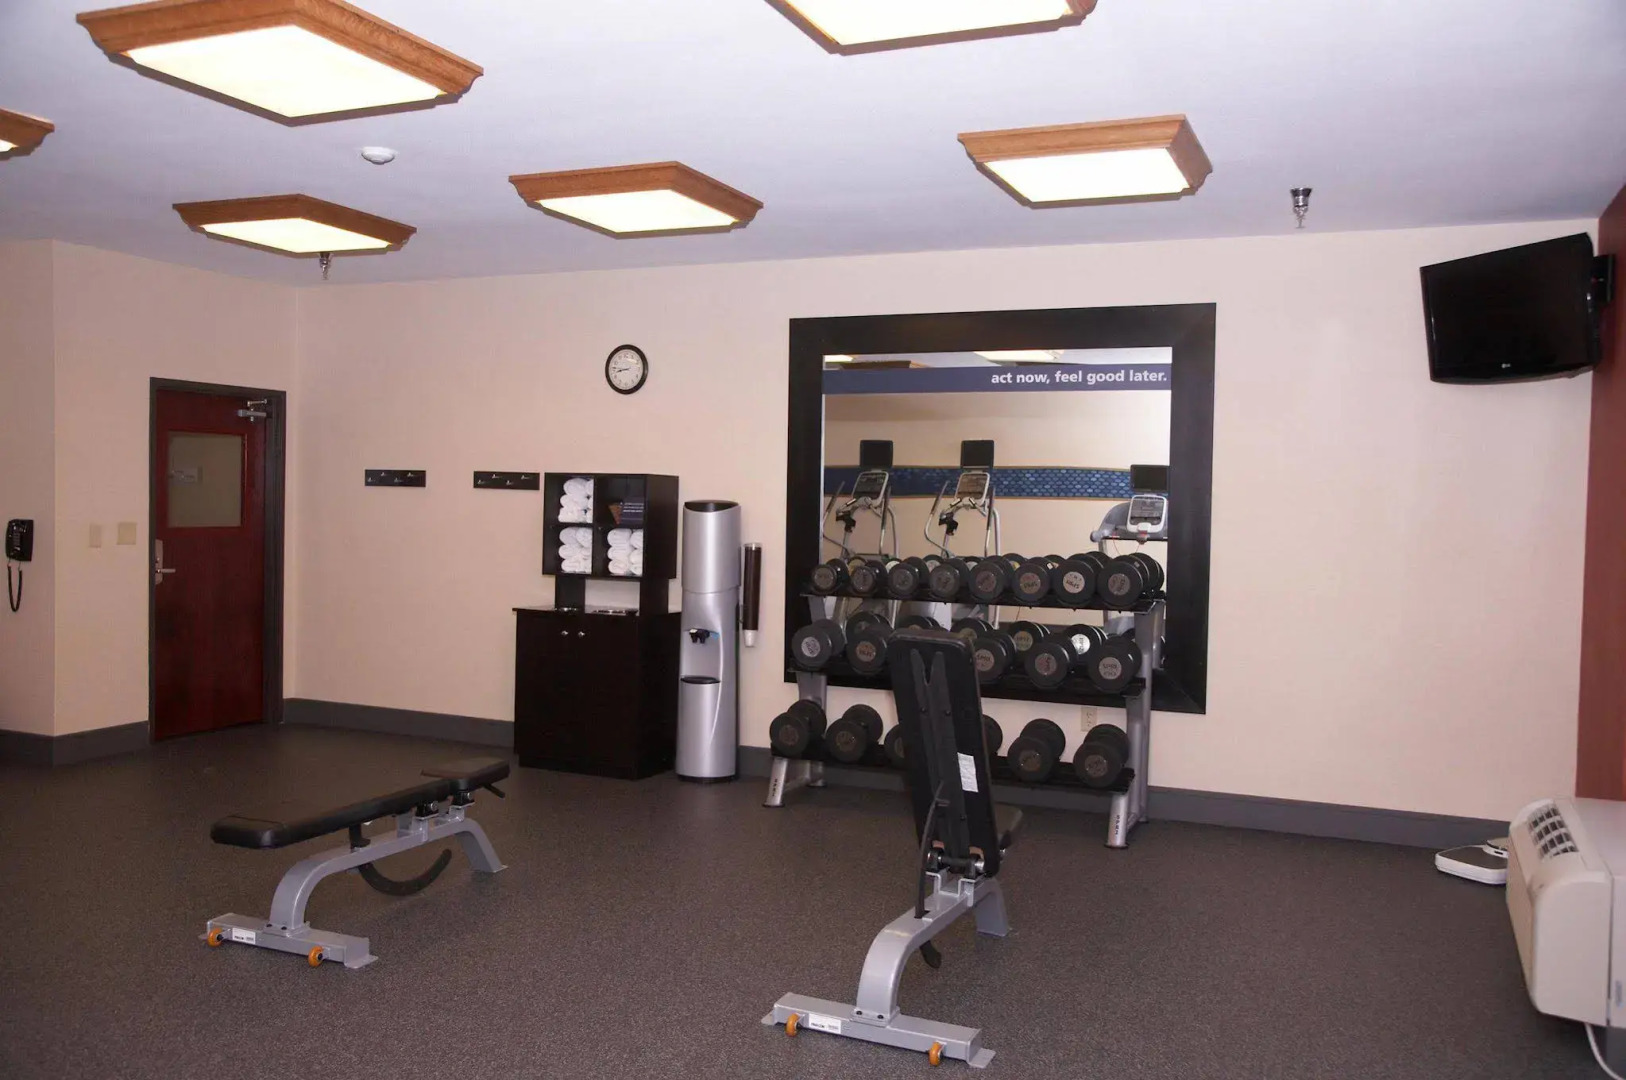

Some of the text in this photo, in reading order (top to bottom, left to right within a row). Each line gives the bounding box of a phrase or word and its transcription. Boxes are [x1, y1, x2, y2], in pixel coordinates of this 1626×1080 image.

[991, 369, 1167, 385] act now, feel good later.
